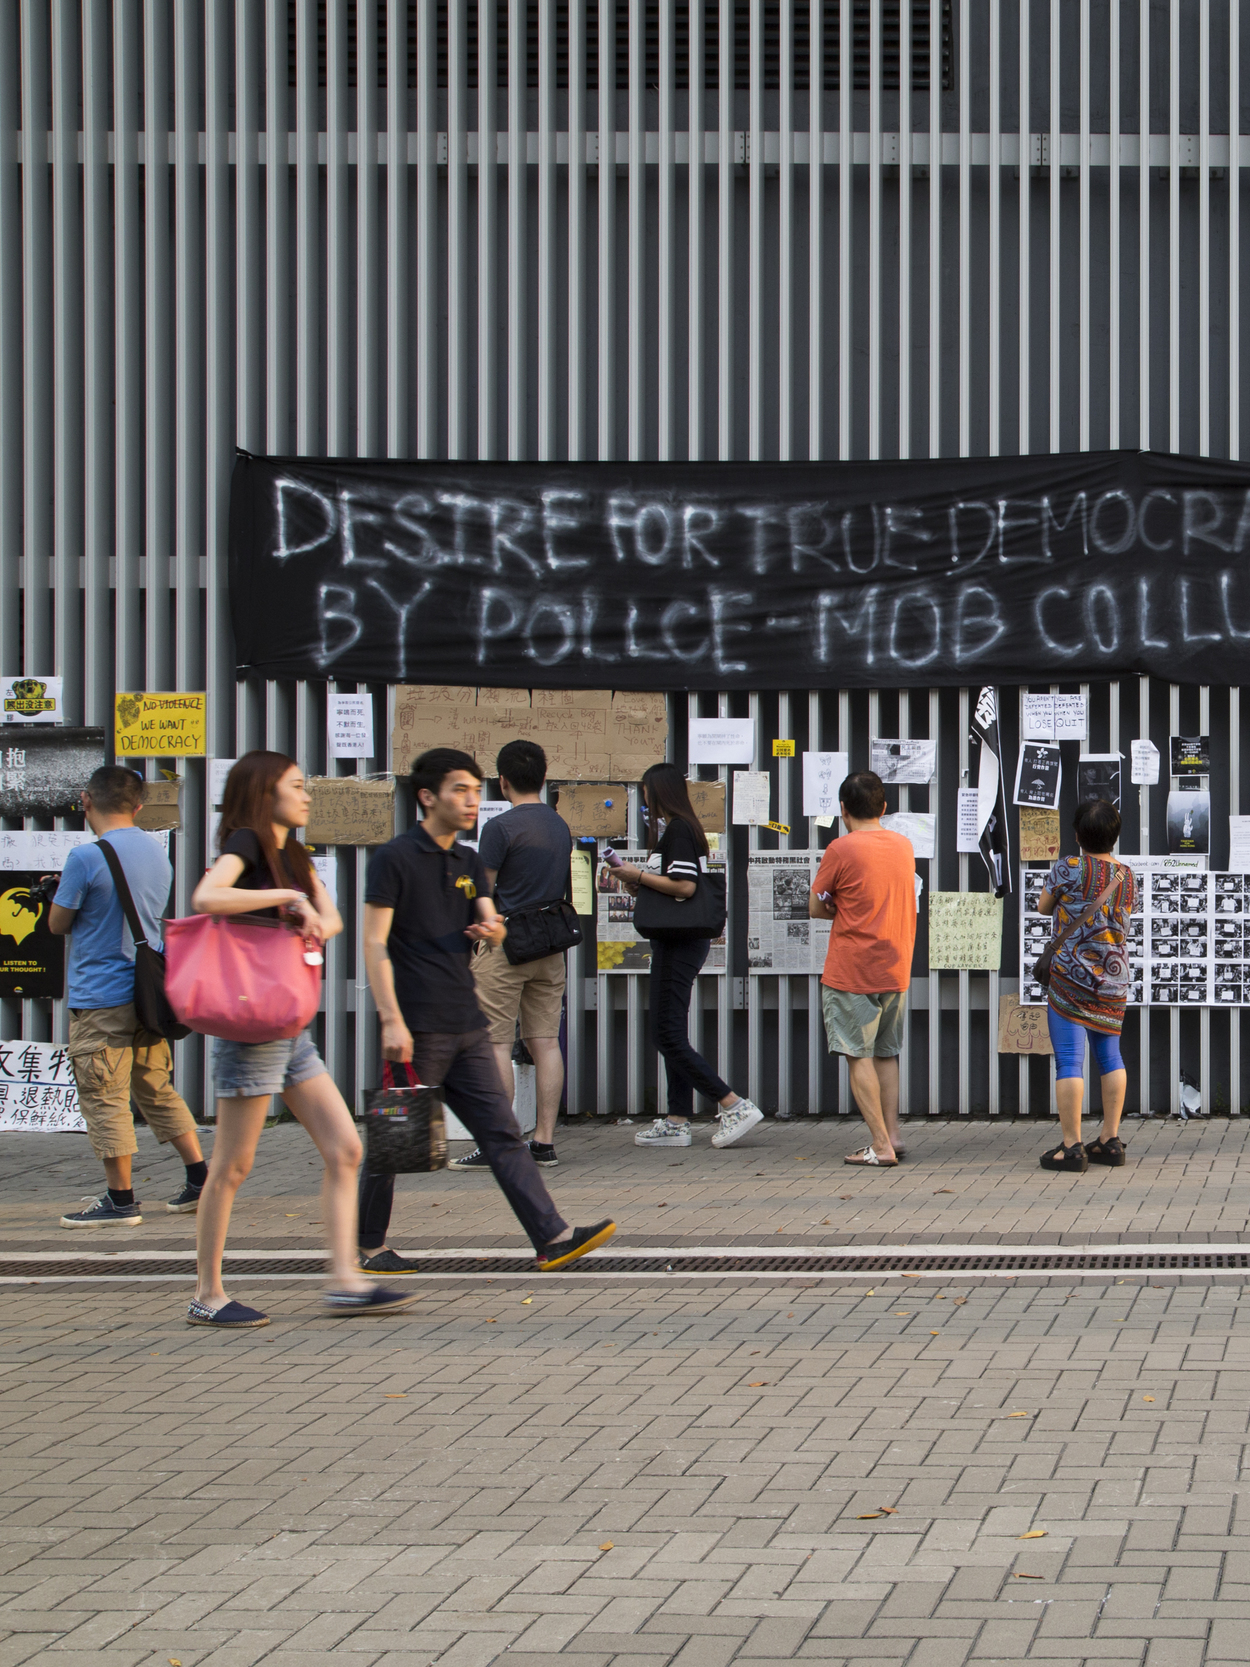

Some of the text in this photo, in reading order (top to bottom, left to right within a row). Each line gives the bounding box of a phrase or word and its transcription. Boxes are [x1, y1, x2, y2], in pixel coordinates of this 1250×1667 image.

[272, 477, 590, 578] DESIRE
[608, 496, 722, 569] FOR
[736, 500, 932, 576] TRUE
[314, 579, 433, 678] BY
[143, 700, 157, 711] NO
[581, 709, 597, 723] Bag
[140, 719, 187, 730] WE WANT
[613, 722, 661, 735] THANK
[1029, 719, 1053, 730] LOSE
[1055, 717, 1086, 729] QUIT
[121, 735, 201, 750] DEMOCRACY
[6, 748, 26, 791] 抱緊
